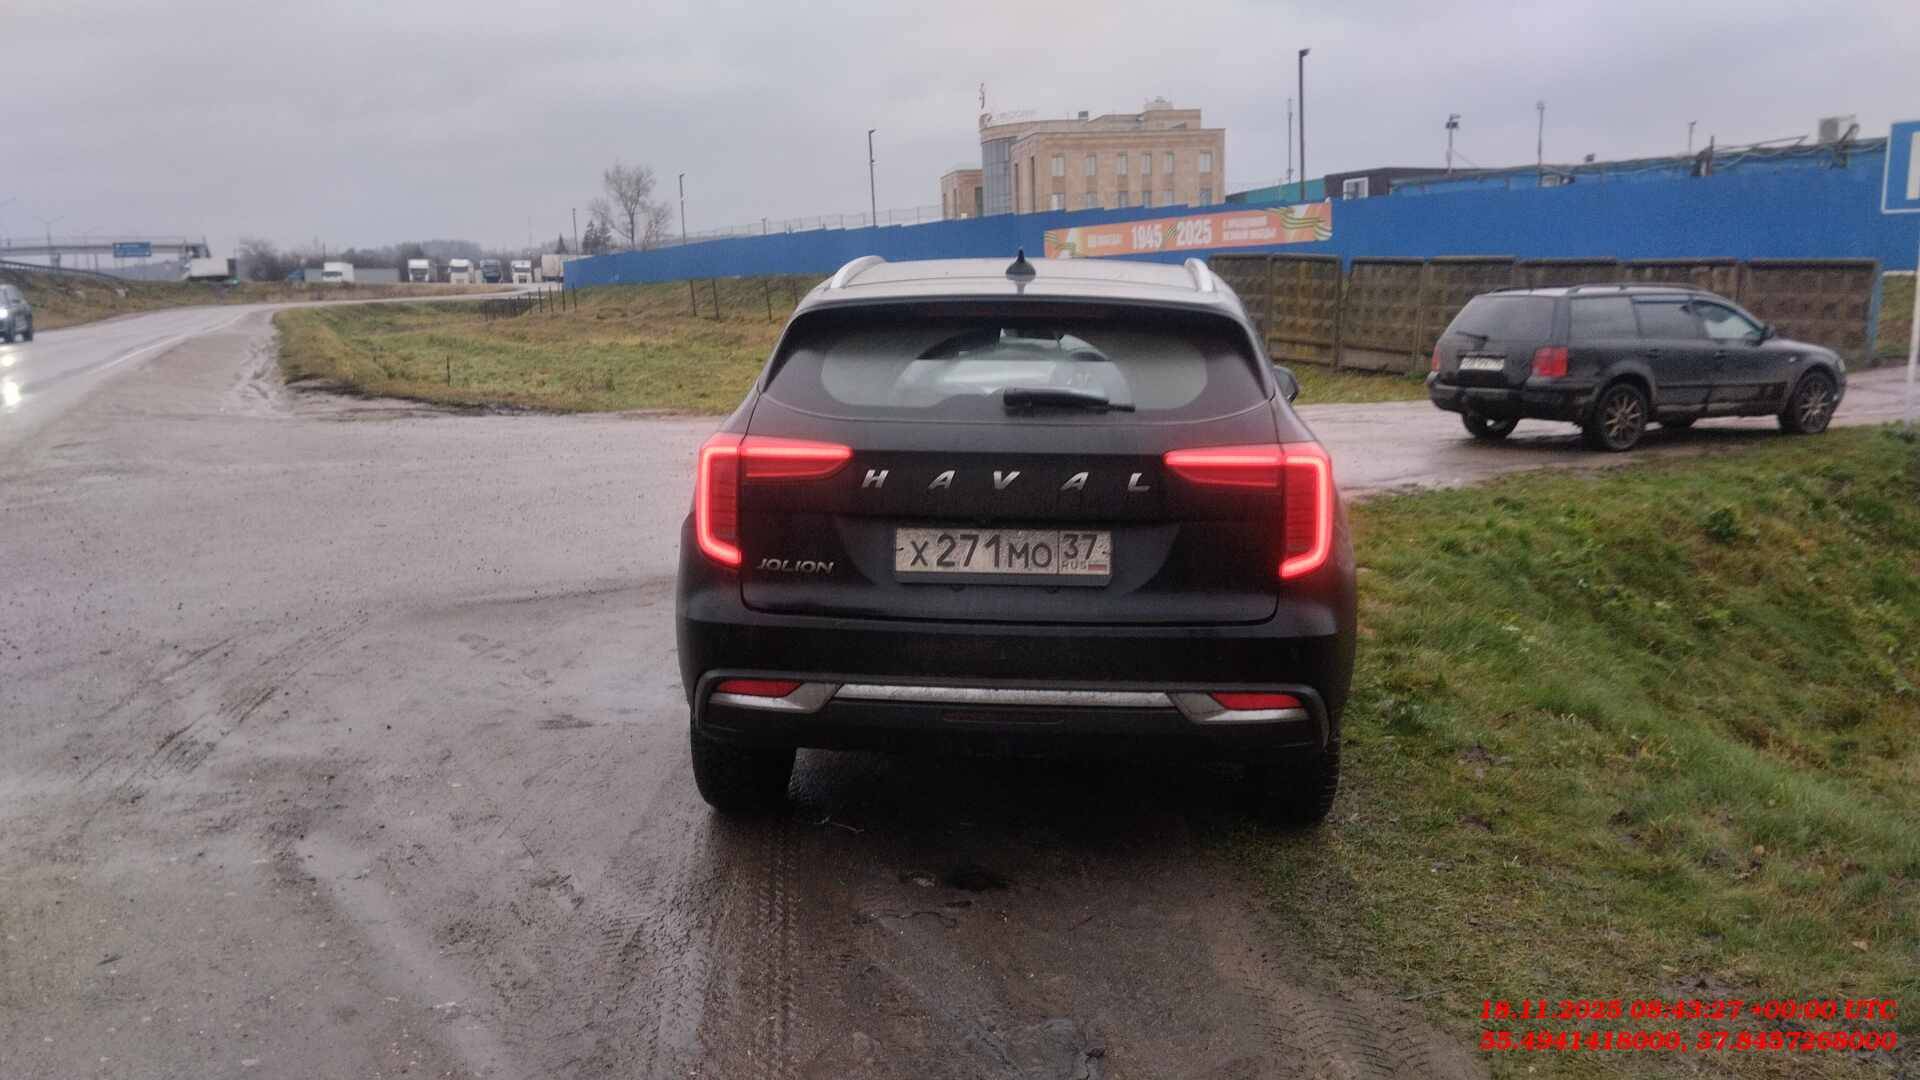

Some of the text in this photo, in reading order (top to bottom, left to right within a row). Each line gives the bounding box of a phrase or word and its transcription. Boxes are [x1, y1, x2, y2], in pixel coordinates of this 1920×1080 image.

[1131, 223, 1163, 249] 1945
[1176, 219, 1212, 246] 2025
[861, 469, 1151, 493] HAVAL
[1063, 533, 1098, 560] 37
[757, 558, 834, 574] JOLION
[1061, 560, 1087, 570] RUS
